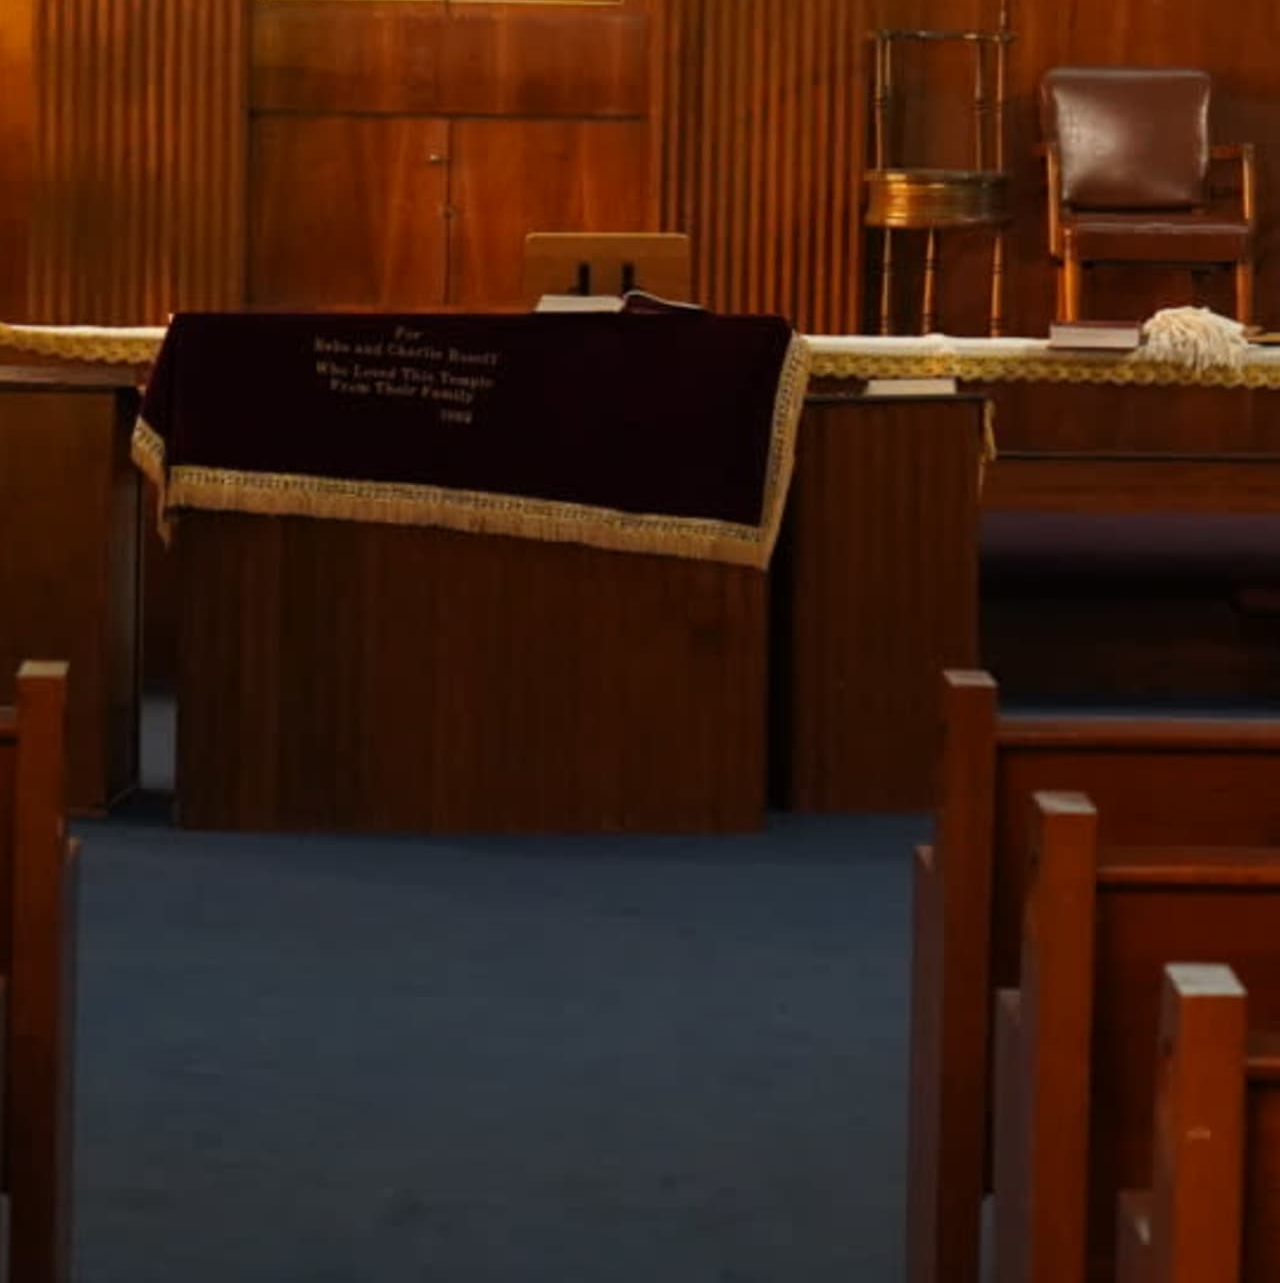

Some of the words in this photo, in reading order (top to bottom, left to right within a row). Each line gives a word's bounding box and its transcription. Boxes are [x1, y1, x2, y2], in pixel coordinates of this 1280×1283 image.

[394, 324, 424, 341] For
[354, 342, 383, 357] and
[316, 360, 348, 377] Who
[353, 363, 397, 380] Loved
[401, 367, 435, 383] This
[439, 370, 495, 390] Temple
[330, 378, 371, 394] From
[420, 384, 474, 405] Family
